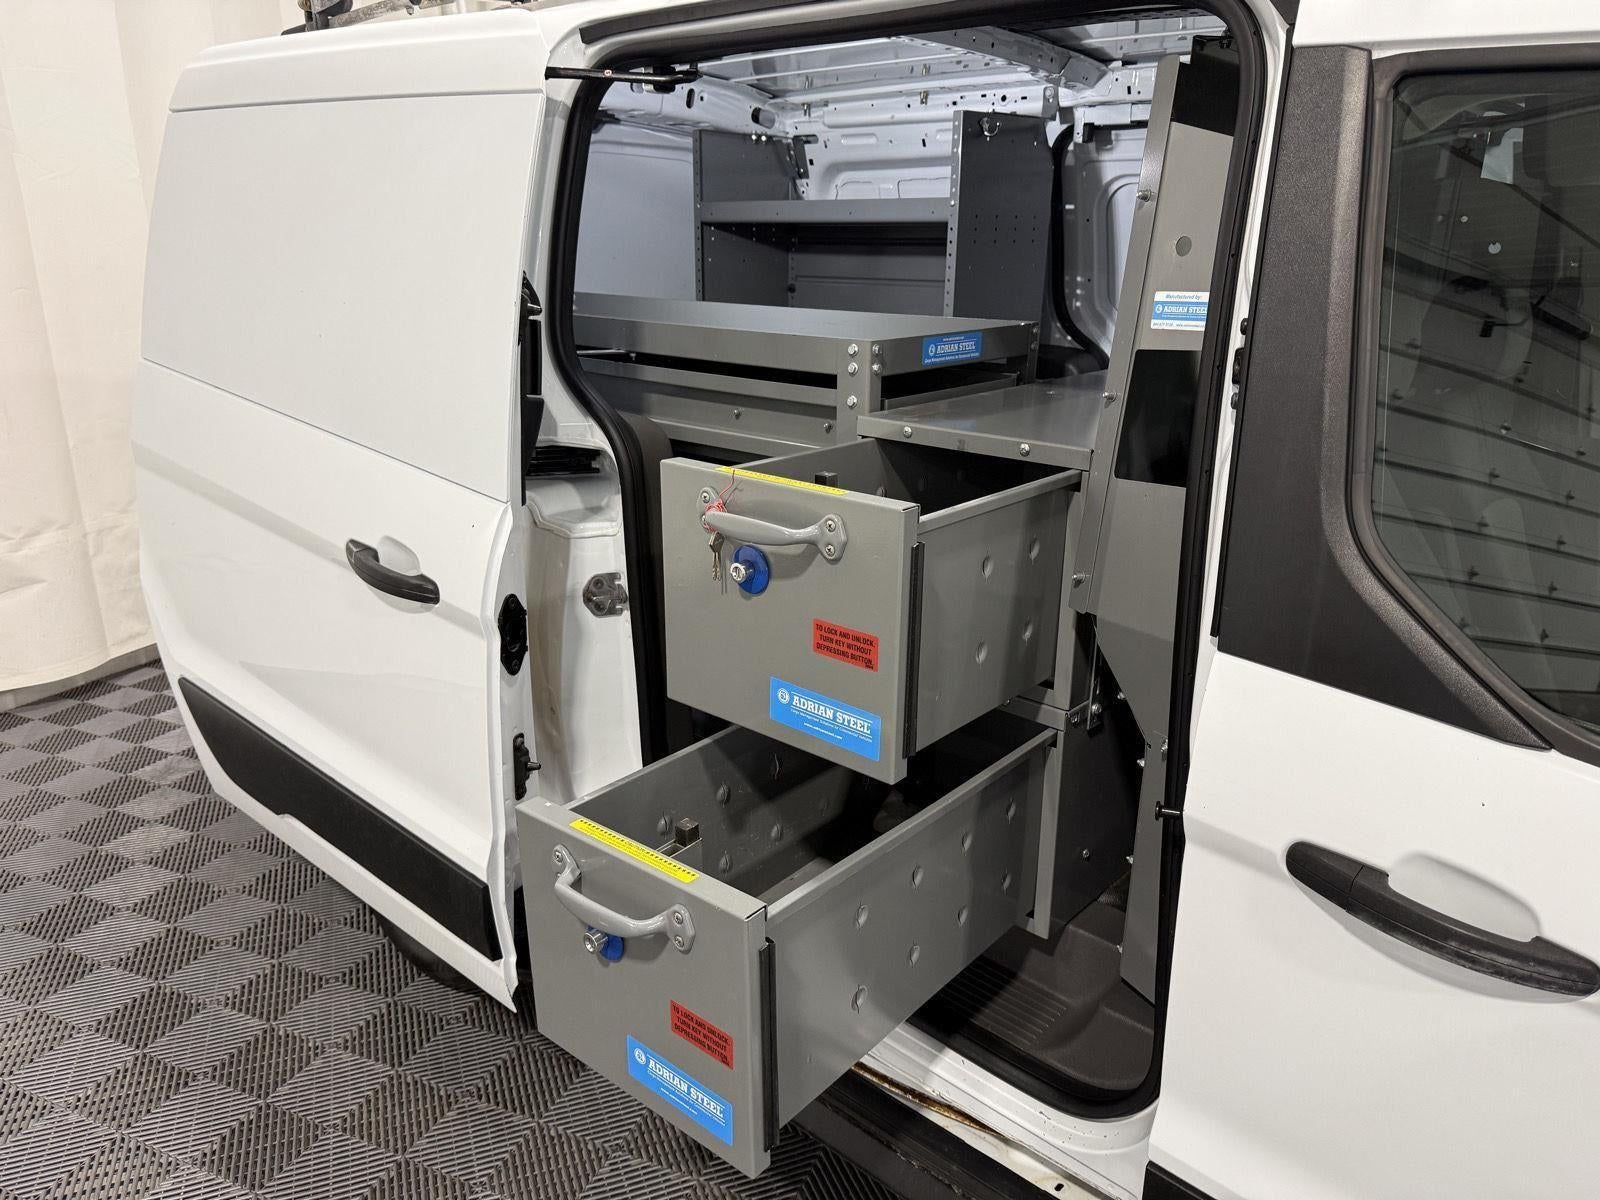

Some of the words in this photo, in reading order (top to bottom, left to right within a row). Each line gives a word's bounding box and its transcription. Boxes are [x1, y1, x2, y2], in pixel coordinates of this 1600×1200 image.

[937, 343, 958, 353] ADRIAN
[959, 341, 976, 350] STEEL
[824, 627, 837, 636] LOCK
[839, 631, 850, 639] AND
[816, 642, 849, 658] DEPRESSING
[820, 634, 834, 644] TURN
[835, 639, 845, 647] KEY
[846, 643, 872, 656] WITHOUT
[793, 695, 833, 719] ADRIAN
[836, 712, 870, 733] STEEL
[673, 1005, 679, 1014] TO
[681, 1010, 694, 1023] LOCK
[696, 1018, 706, 1030] AND
[677, 1016, 690, 1029] TURN
[692, 1025, 701, 1035] KEY
[702, 1032, 726, 1051] WITHOUT
[648, 1059, 688, 1093] ADRIAN
[690, 1088, 724, 1118] STEEL
